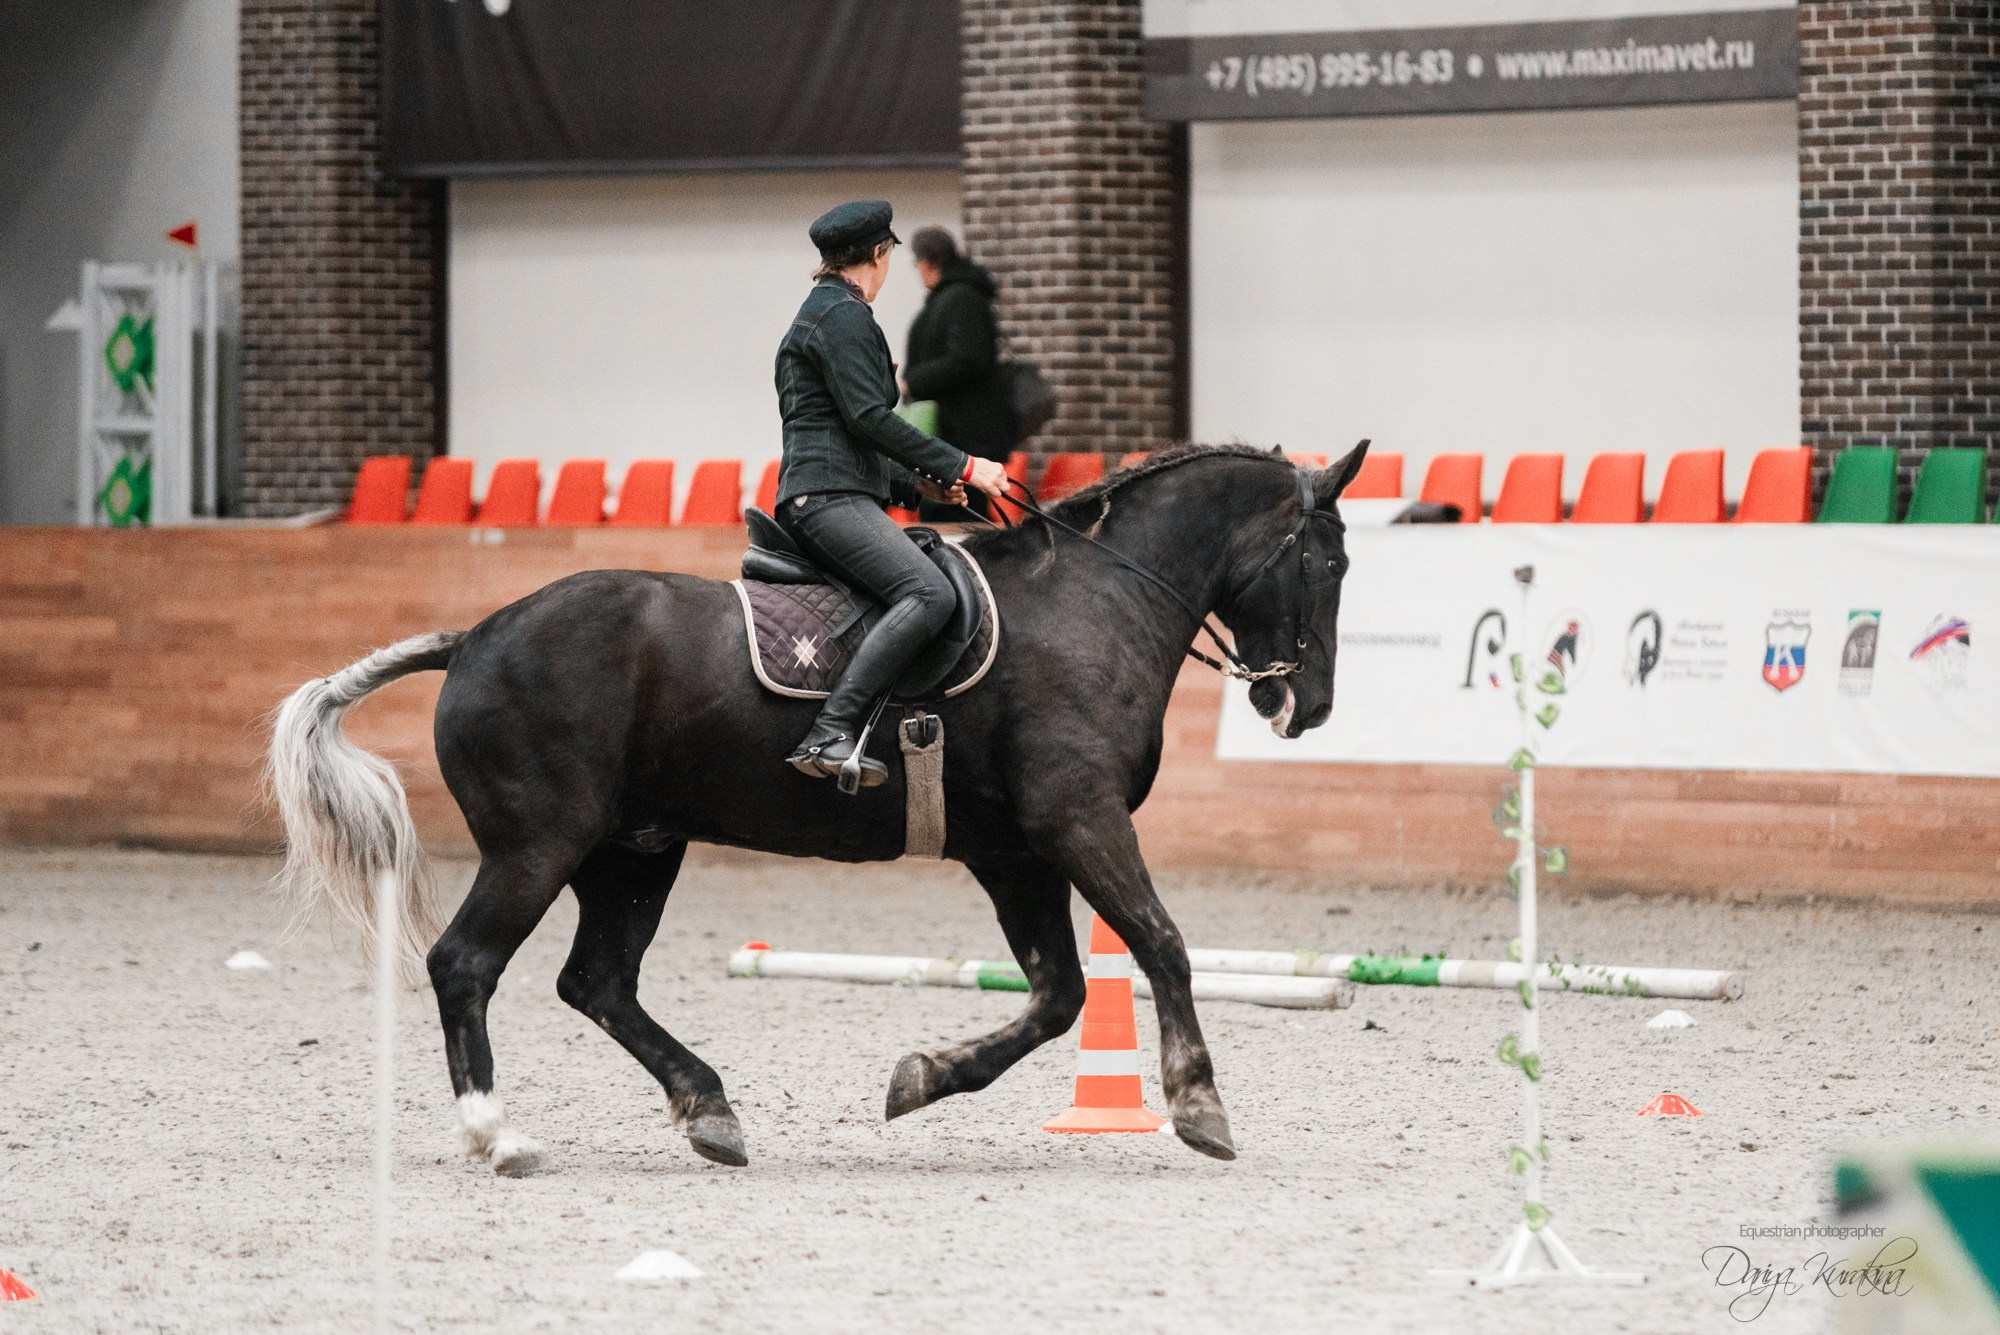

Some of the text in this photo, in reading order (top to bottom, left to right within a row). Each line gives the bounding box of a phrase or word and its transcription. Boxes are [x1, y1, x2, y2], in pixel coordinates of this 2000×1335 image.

[1206, 36, 1755, 97] +7 (495) 995-16-83 www.maximavet.ru
